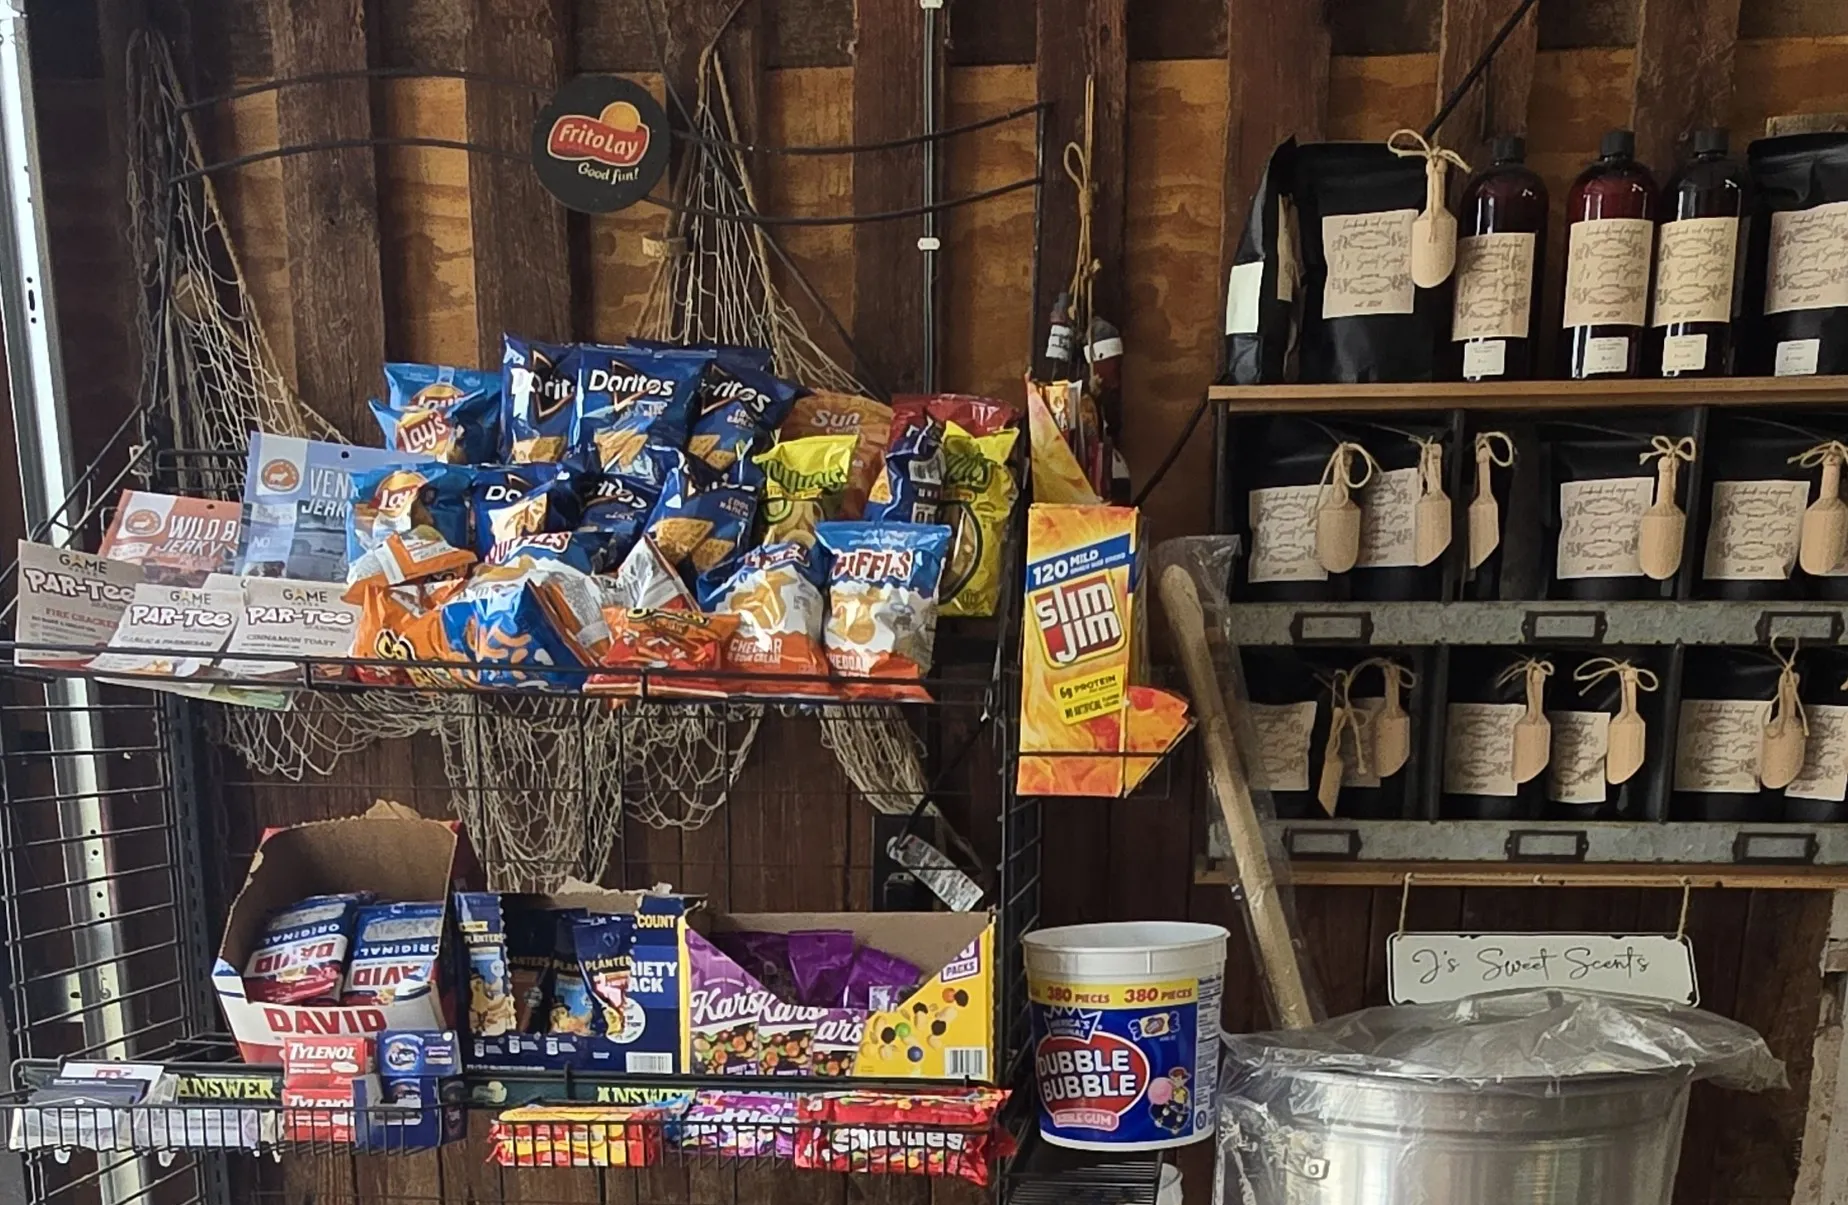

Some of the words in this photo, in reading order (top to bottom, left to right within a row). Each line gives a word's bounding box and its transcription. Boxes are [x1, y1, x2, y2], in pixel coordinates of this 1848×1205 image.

[578, 162, 609, 180] Good
[611, 167, 639, 185] fun!
[589, 369, 675, 396] Doritos
[810, 408, 862, 428] Sun
[400, 413, 447, 454] Lay's
[310, 467, 349, 499] VEN
[301, 499, 346, 518] JERK
[168, 515, 219, 541] WILD
[156, 538, 223, 556] JERKY
[252, 536, 271, 549] NO
[1033, 560, 1069, 585] 120
[1070, 550, 1099, 567] MILD
[282, 588, 328, 604] GAME
[246, 634, 301, 644] CINNAMON
[304, 638, 336, 648] TOAST
[754, 653, 781, 665] CREAM
[1074, 674, 1116, 693] PROTEIN
[637, 914, 676, 929] COUNT
[265, 923, 340, 944] ORIGINAL
[464, 933, 506, 944] PLANTERS
[254, 942, 336, 974] DAVID
[585, 955, 632, 971] PLANTER
[1412, 948, 1460, 984] J's
[1476, 947, 1558, 981] Sweet
[1564, 946, 1650, 980] Scents
[353, 964, 420, 987] AVID
[946, 961, 976, 979] PACKS
[629, 977, 665, 993] ACK
[1047, 986, 1072, 1002] 380
[1075, 993, 1110, 1004] PIECES
[1124, 987, 1158, 1003] 380
[1162, 988, 1193, 1001] PIECES
[263, 1007, 388, 1035] DAVID
[289, 1042, 356, 1060] TYLENOL
[1039, 1049, 1130, 1075] DUBBLE
[178, 1077, 275, 1099] ANSWER
[1043, 1074, 1137, 1101] BUBBLE
[1084, 1113, 1112, 1126] GUM
